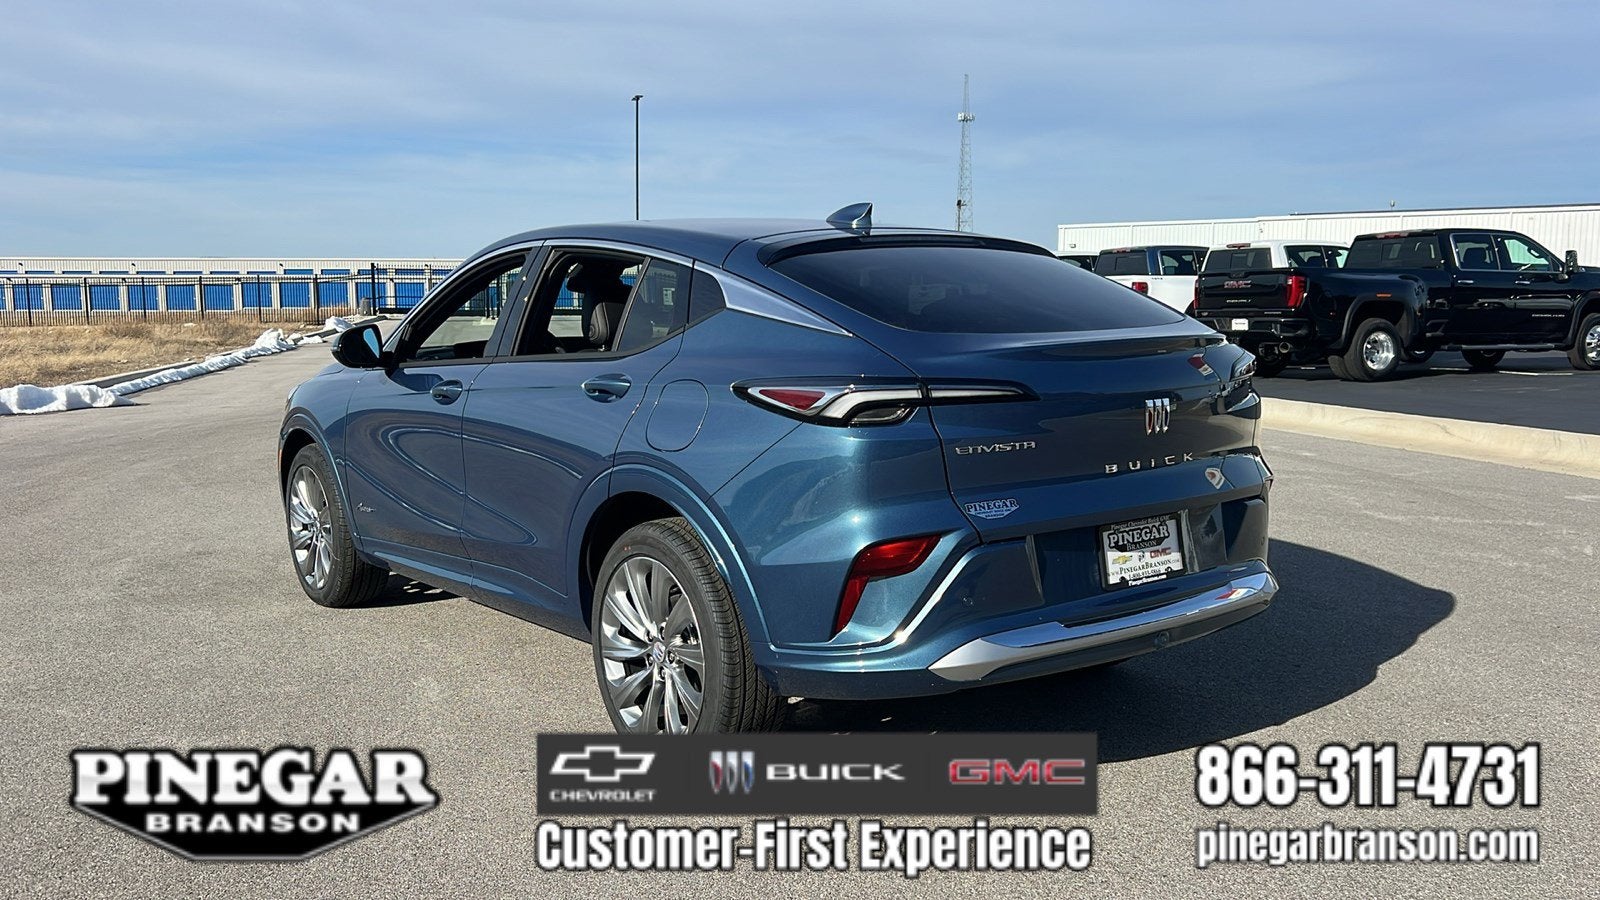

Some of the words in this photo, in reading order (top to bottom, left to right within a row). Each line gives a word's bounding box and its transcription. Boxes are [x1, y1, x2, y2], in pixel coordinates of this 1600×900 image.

[1223, 280, 1252, 289] GMC
[955, 440, 1036, 455] ENVISTA
[1105, 452, 1194, 474] BUICK
[965, 498, 1019, 513] PINEGAR
[1108, 525, 1169, 547] PINEGAR
[1126, 539, 1157, 551] BRANSON
[1150, 547, 1171, 558] GMC
